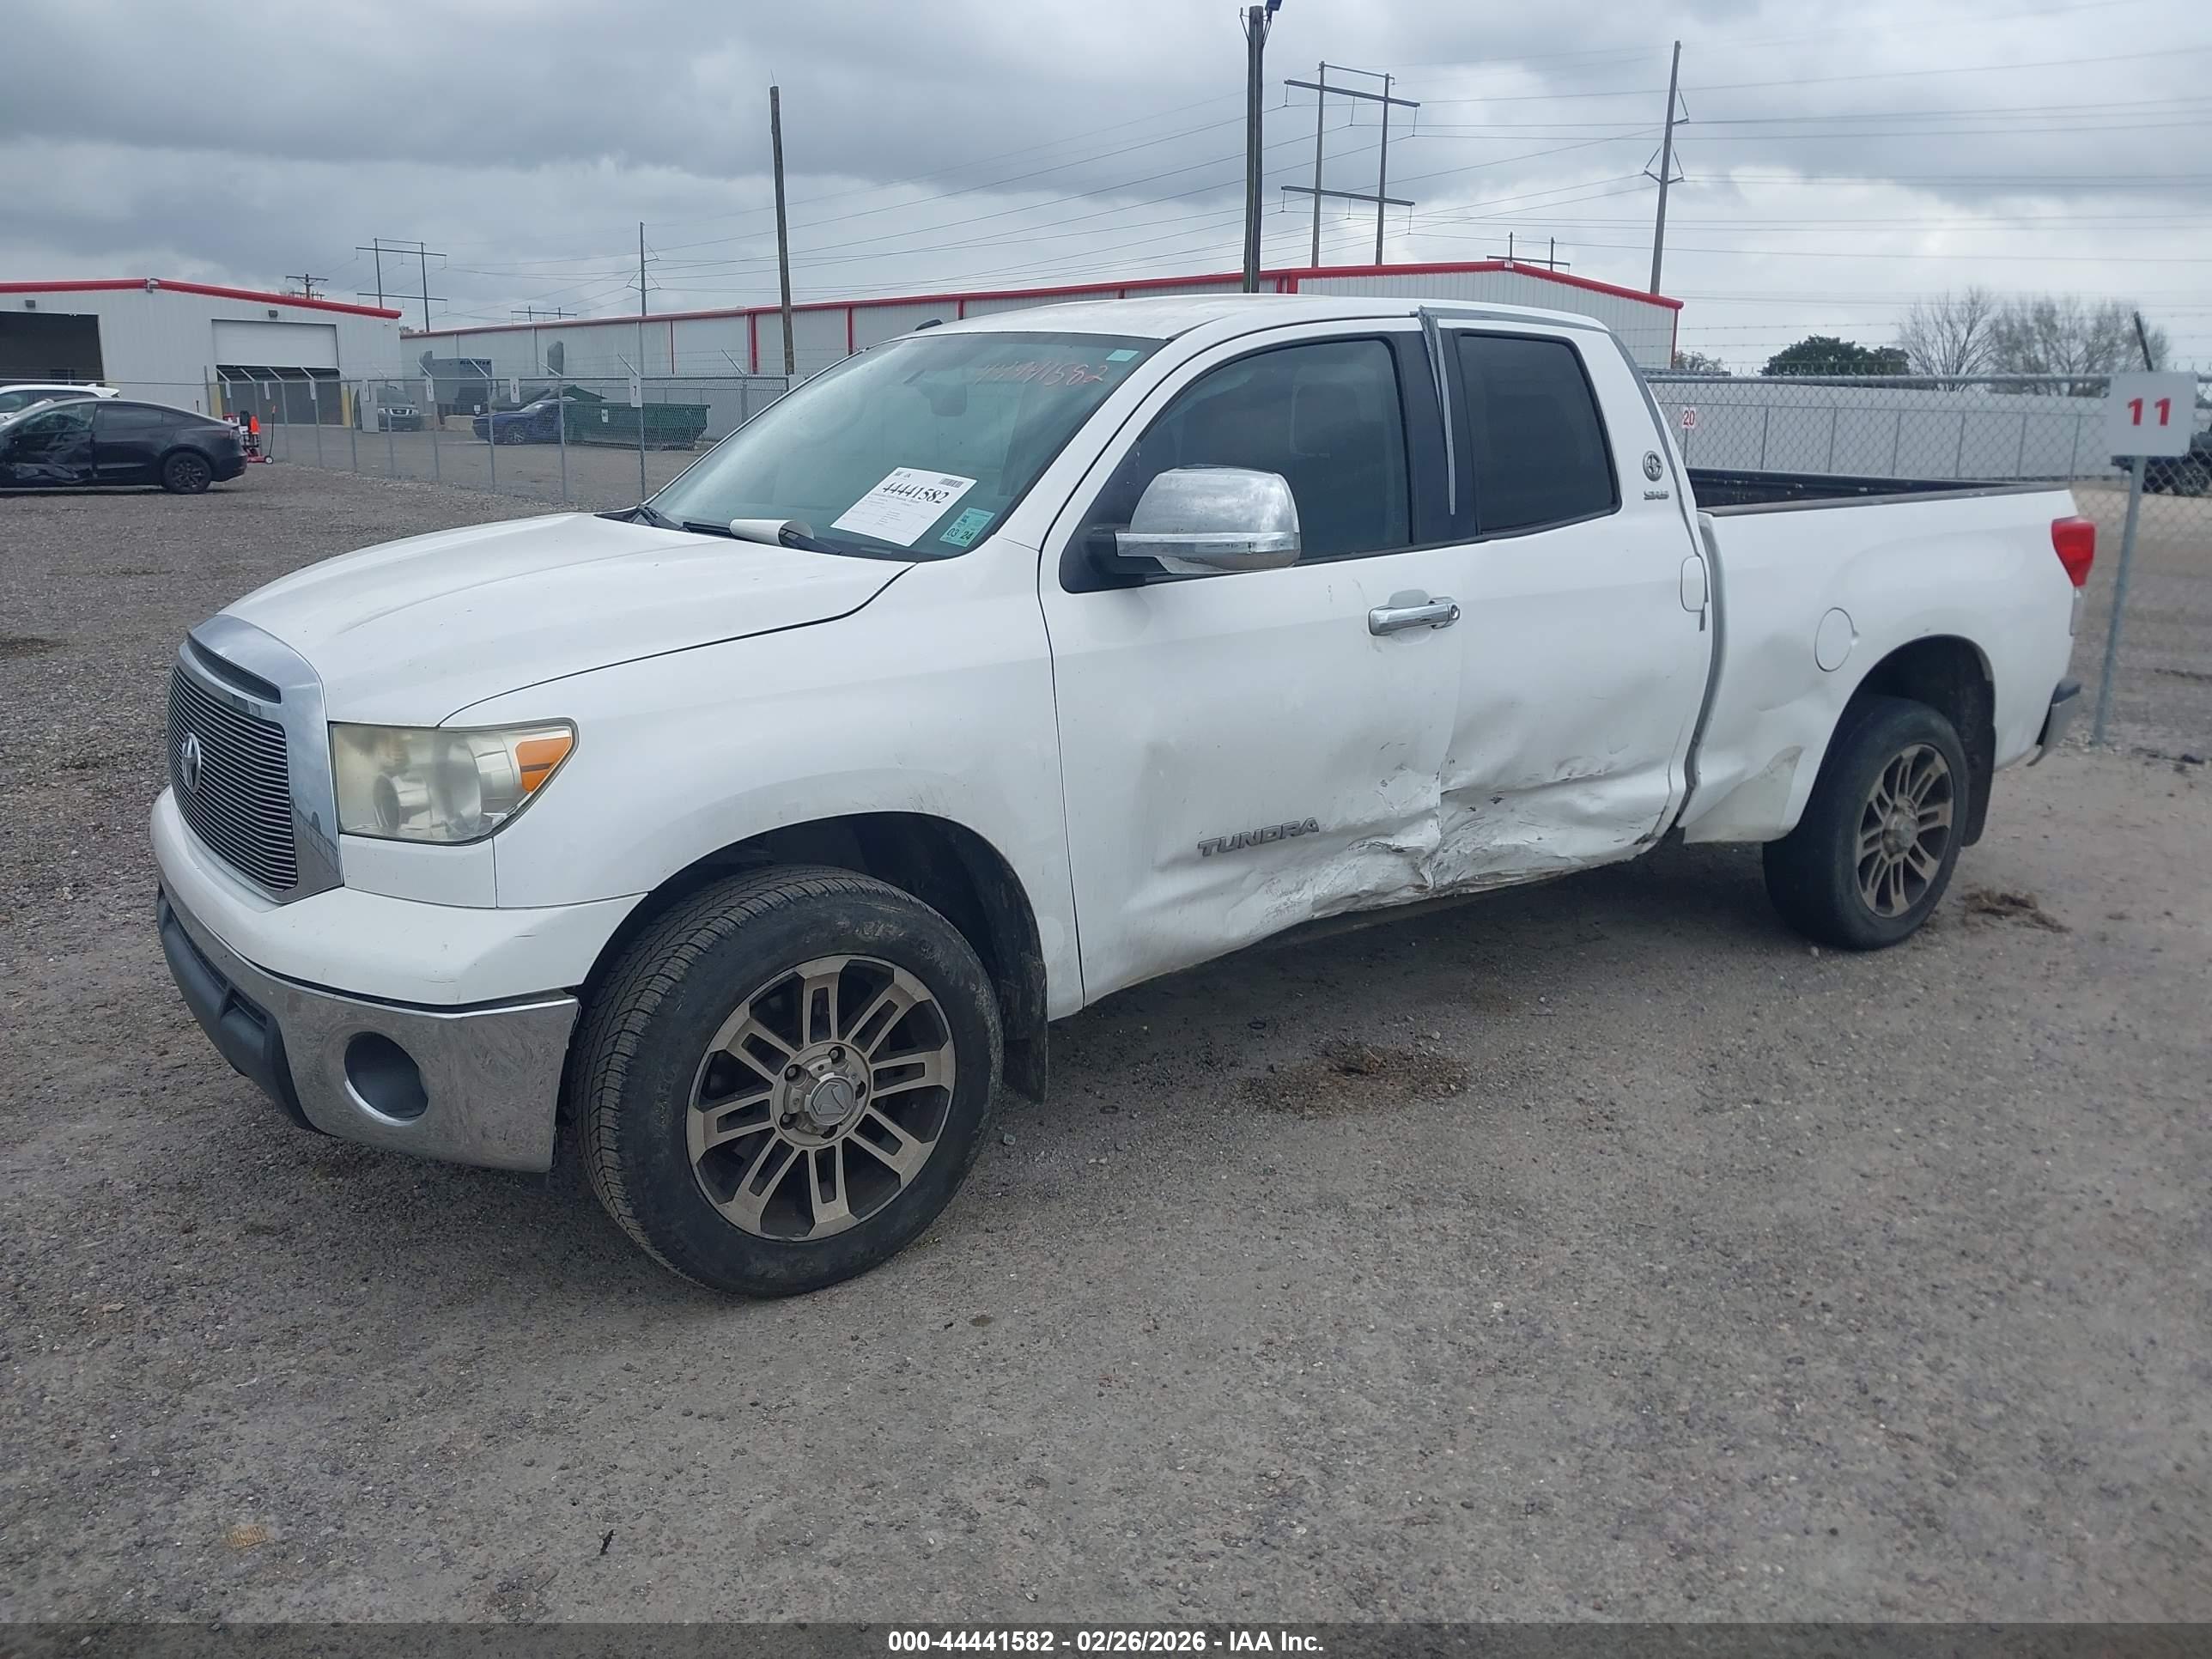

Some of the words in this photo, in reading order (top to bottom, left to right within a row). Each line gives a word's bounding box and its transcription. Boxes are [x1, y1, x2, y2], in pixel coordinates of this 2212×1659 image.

[633, 385, 637, 396] 7
[1683, 410, 1695, 426] 20
[2127, 398, 2172, 427] 11
[882, 482, 950, 504] 44441582
[946, 527, 959, 537] 03
[960, 531, 974, 540] 24
[1197, 817, 1320, 857] TUNDRA
